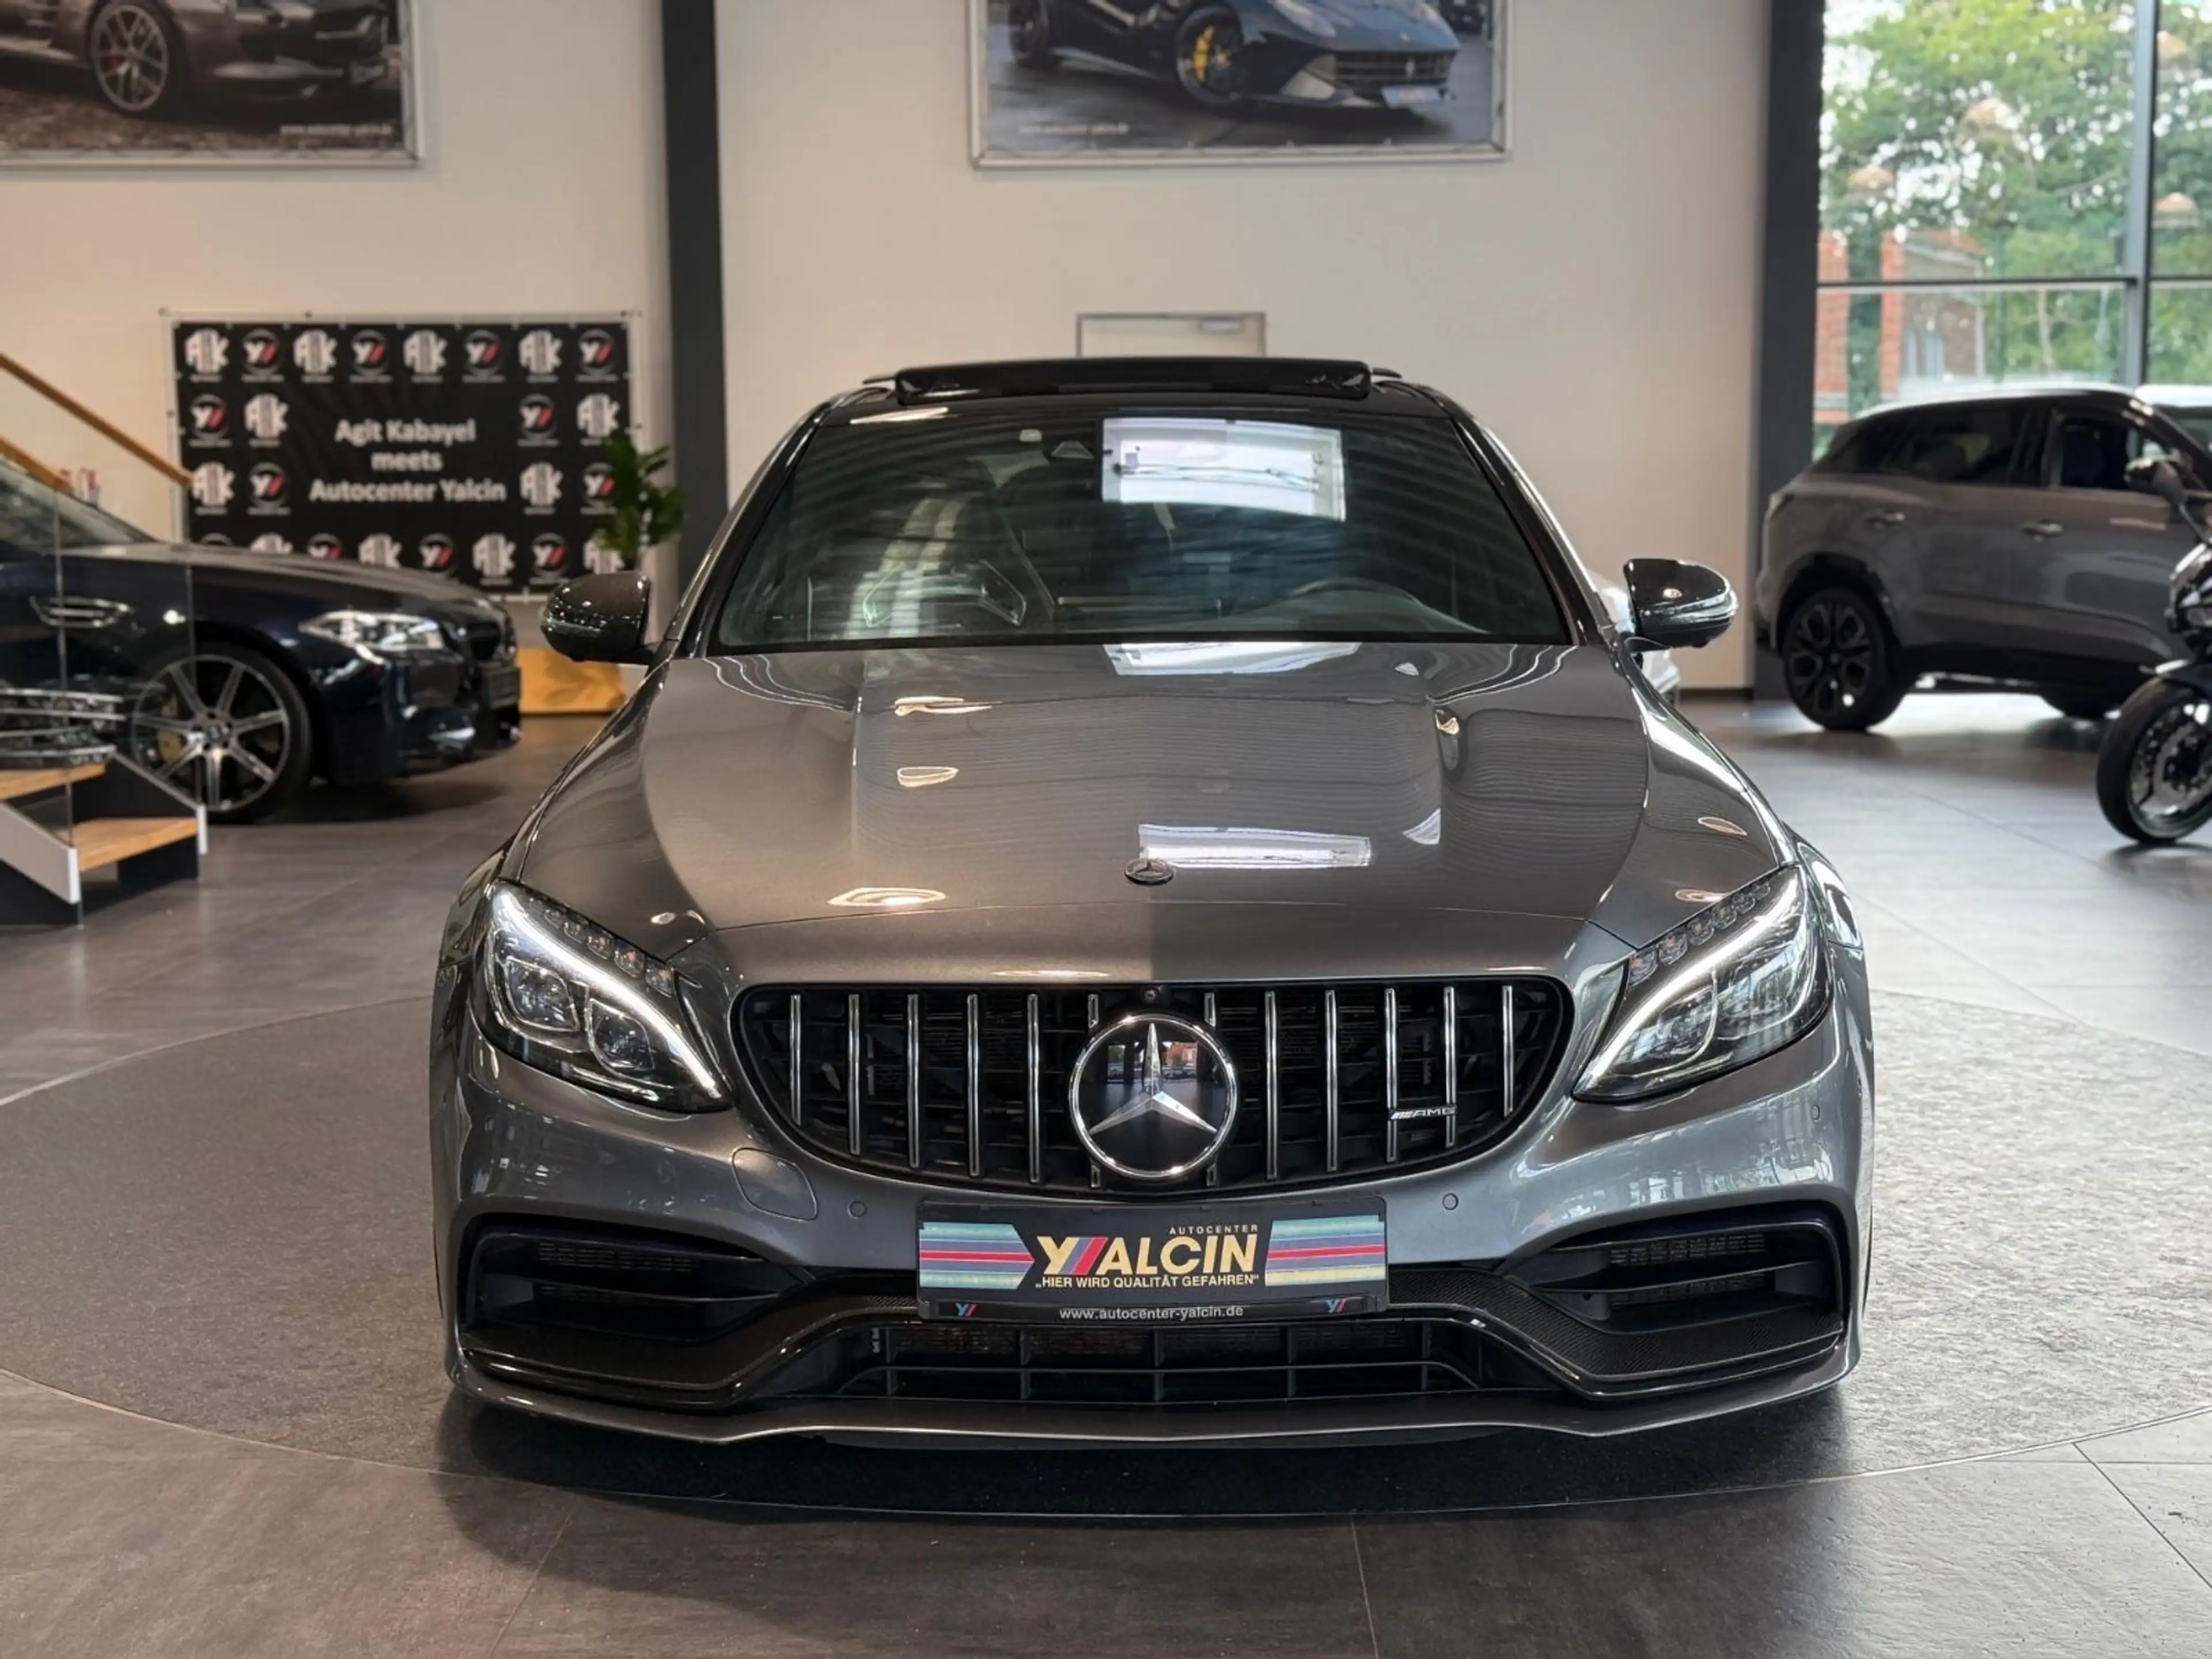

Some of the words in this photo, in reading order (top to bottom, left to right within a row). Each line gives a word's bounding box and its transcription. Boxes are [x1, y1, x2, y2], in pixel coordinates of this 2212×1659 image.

[335, 418, 382, 447] Agit
[385, 417, 476, 447] Kabayel
[371, 449, 443, 471] meets
[308, 478, 436, 502] Autocenter
[440, 477, 506, 502] Yalcin
[1411, 1107, 1456, 1118] AMG
[1169, 1224, 1258, 1235] AUTOCENTER
[1075, 1277, 1110, 1289] WIRD
[1113, 1274, 1179, 1289] QUALITÄT
[1059, 1305, 1244, 1321] www.autocenter-yalcin.de
